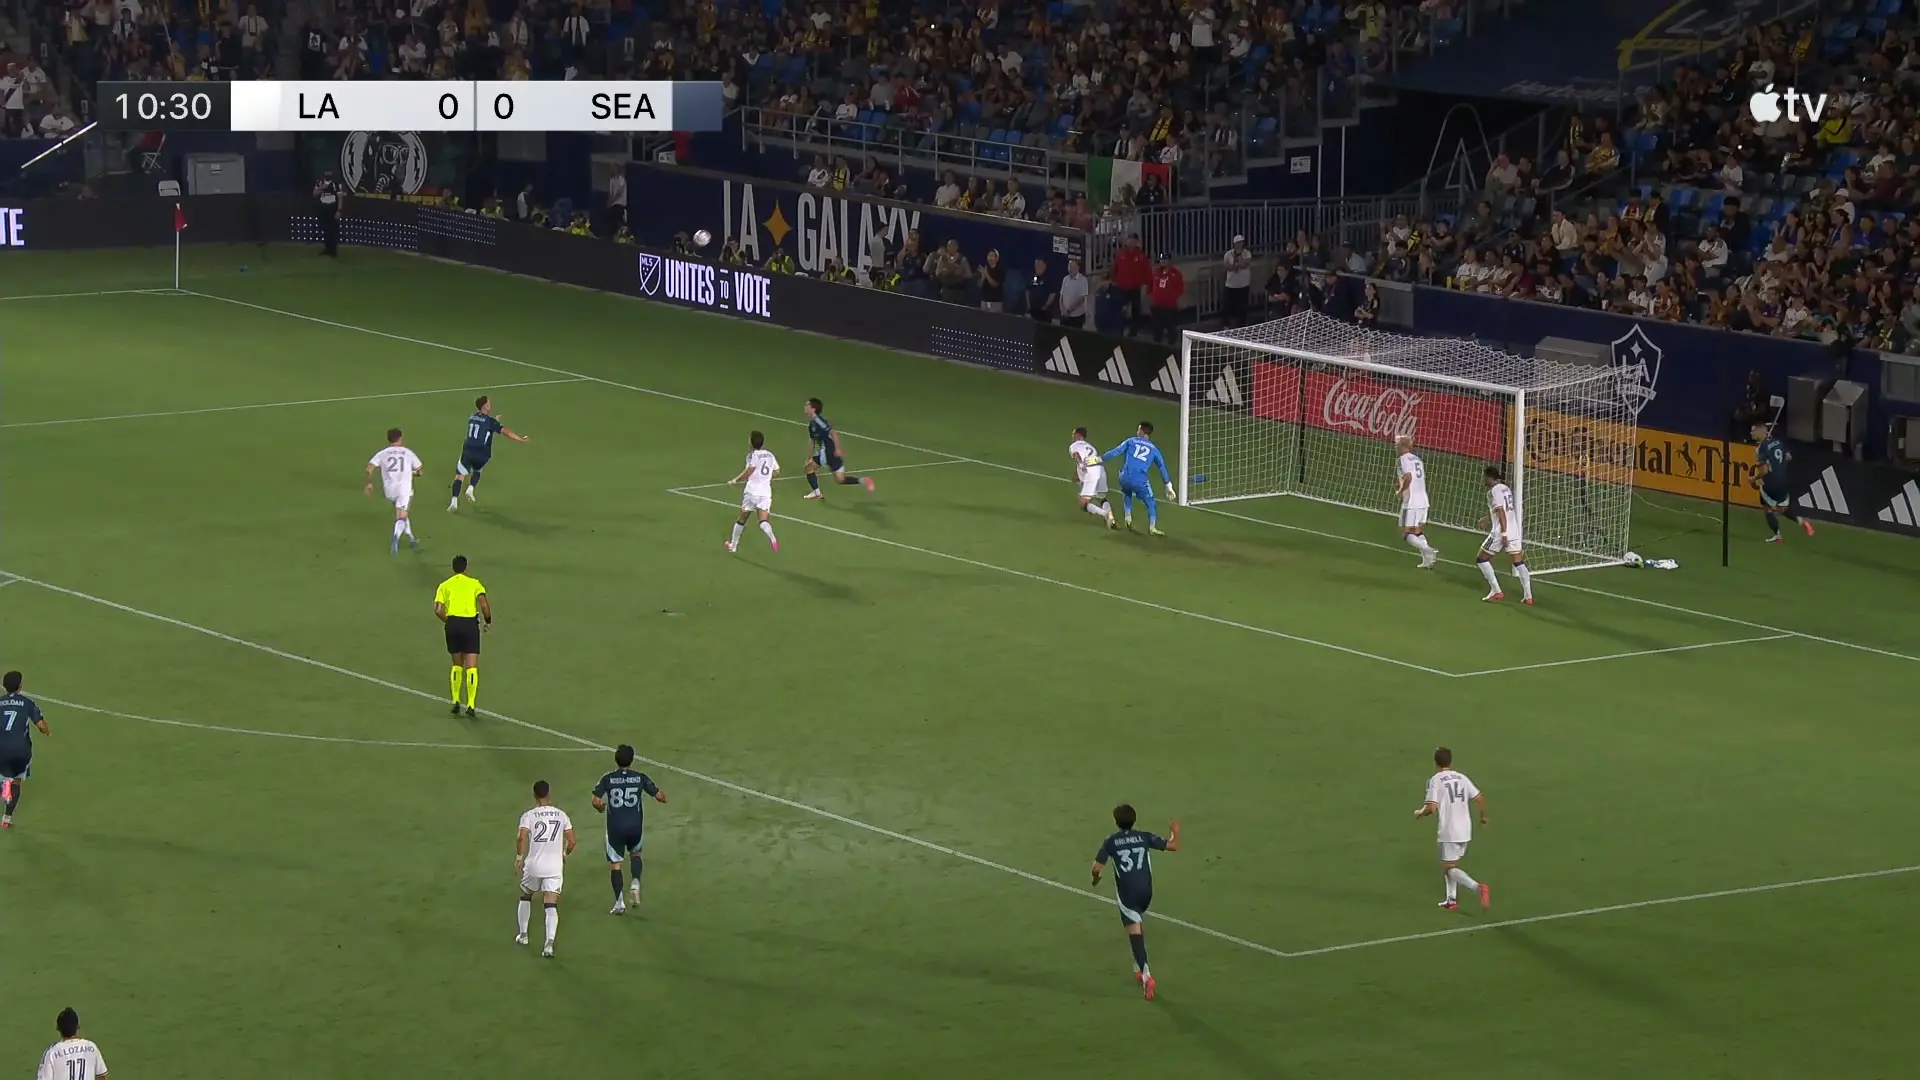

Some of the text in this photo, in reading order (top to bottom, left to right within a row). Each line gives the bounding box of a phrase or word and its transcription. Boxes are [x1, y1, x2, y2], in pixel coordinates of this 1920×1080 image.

[665, 258, 771, 317] UNITES TO VOTE
[468, 423, 480, 440] 11
[1133, 444, 1151, 462] 12
[1774, 448, 1783, 464] 9
[386, 456, 406, 473] 21
[760, 460, 770, 476] 6
[1414, 462, 1423, 479] 5
[3, 710, 18, 731] 7
[609, 787, 639, 809] 85
[1444, 781, 1465, 804] 14
[533, 820, 561, 843] 27
[1116, 846, 1146, 873] 37
[63, 1045, 95, 1056] LOZANO
